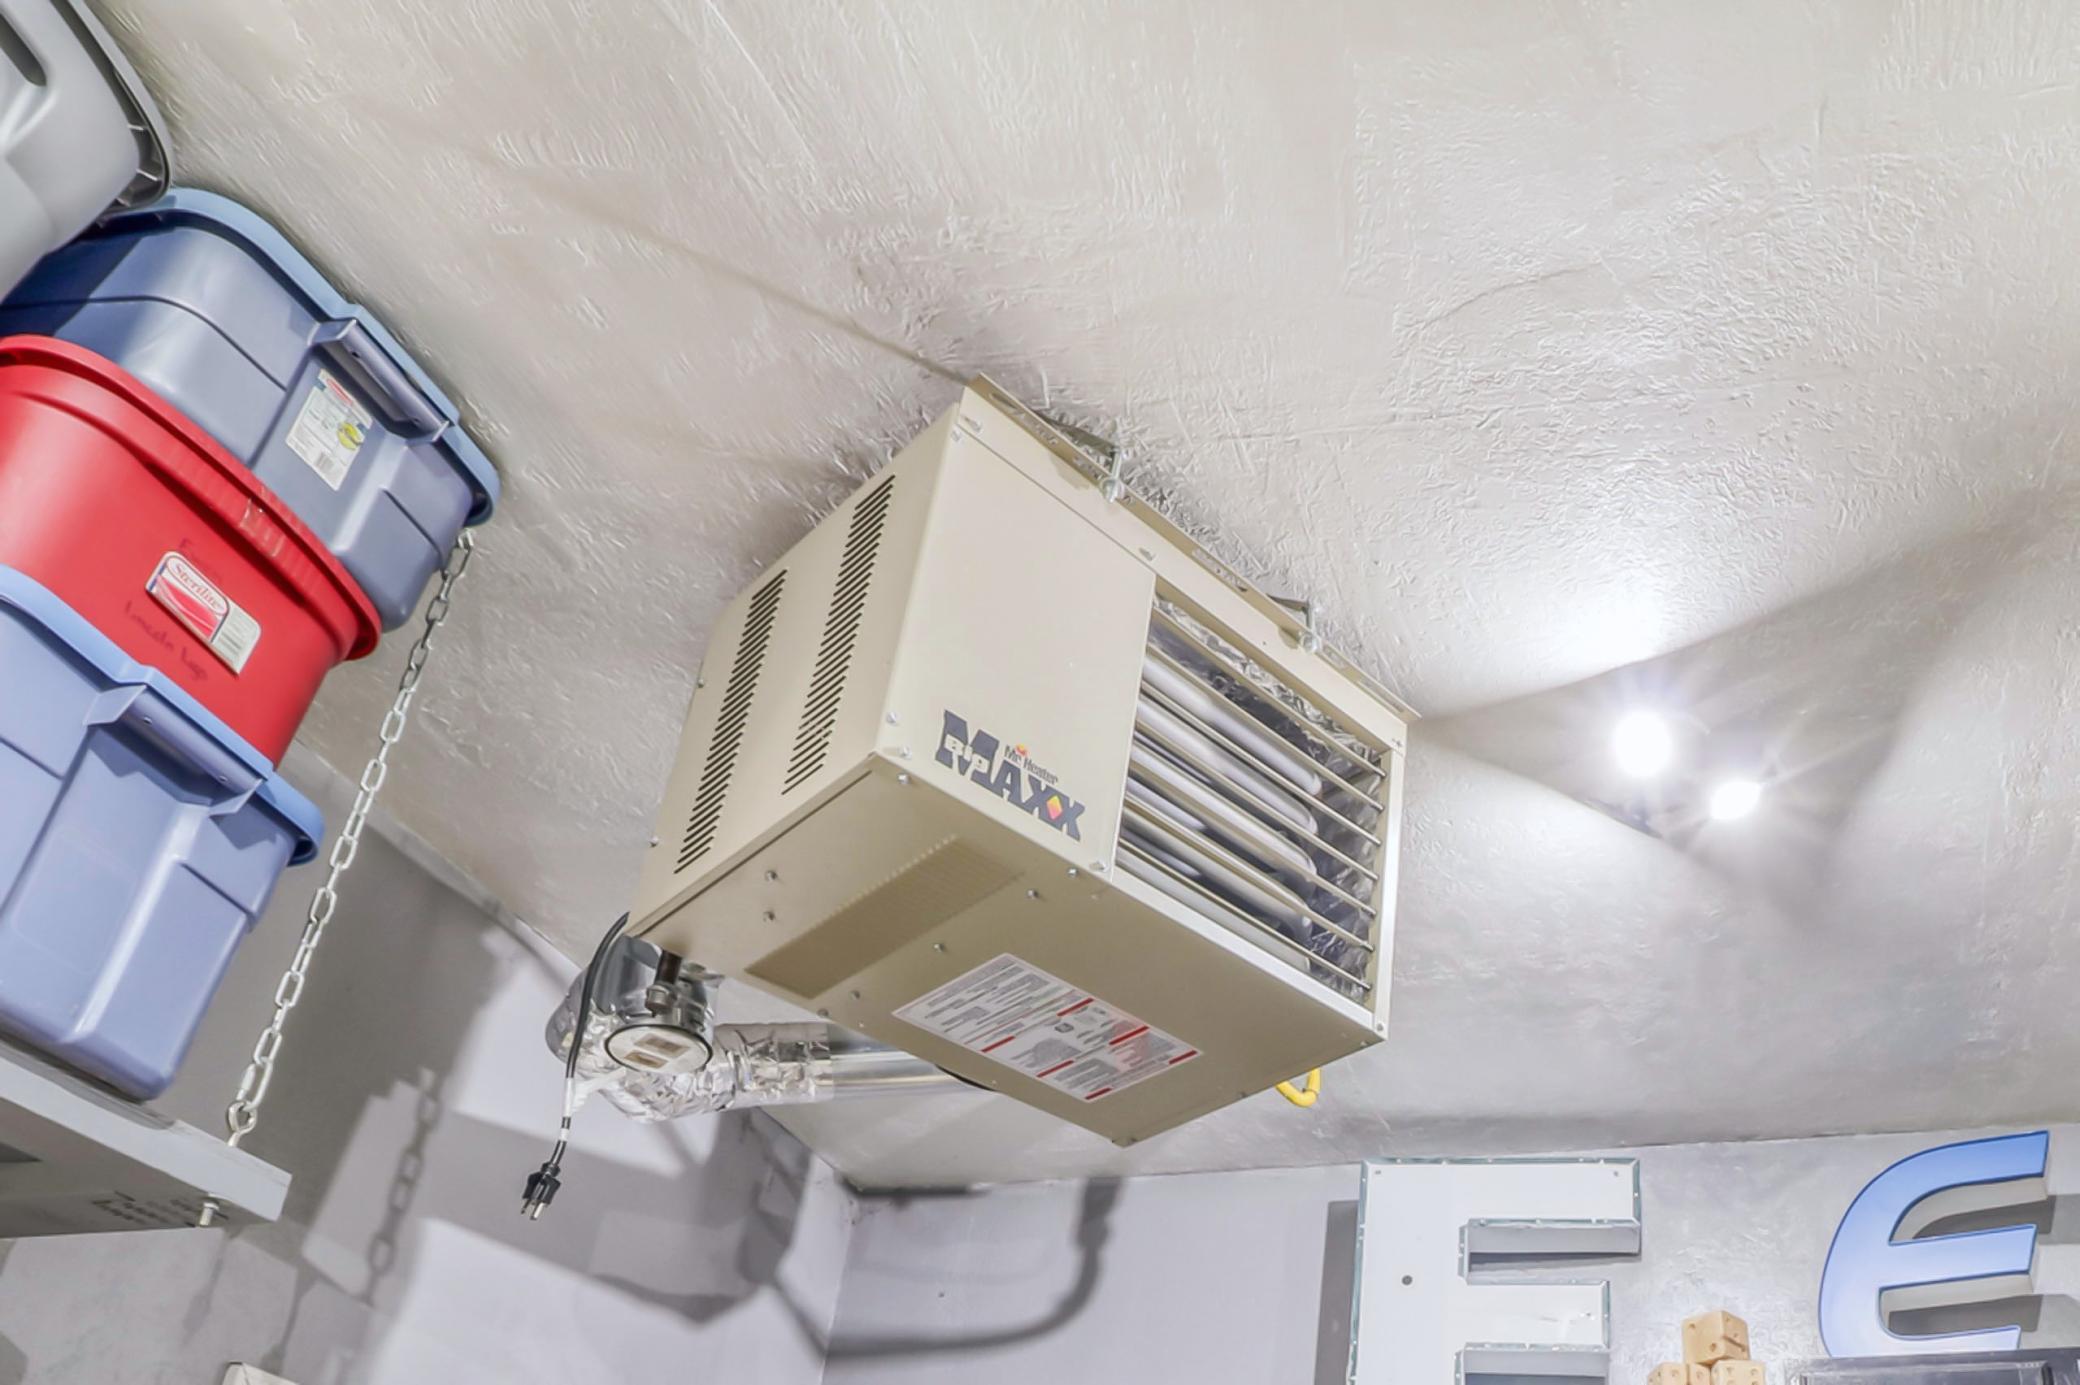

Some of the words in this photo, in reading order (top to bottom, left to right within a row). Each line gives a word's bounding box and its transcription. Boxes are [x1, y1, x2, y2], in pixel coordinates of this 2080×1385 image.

[175, 561, 222, 610] Sterilite
[935, 709, 1085, 842] MAXX
[1023, 756, 1058, 786] Heater
